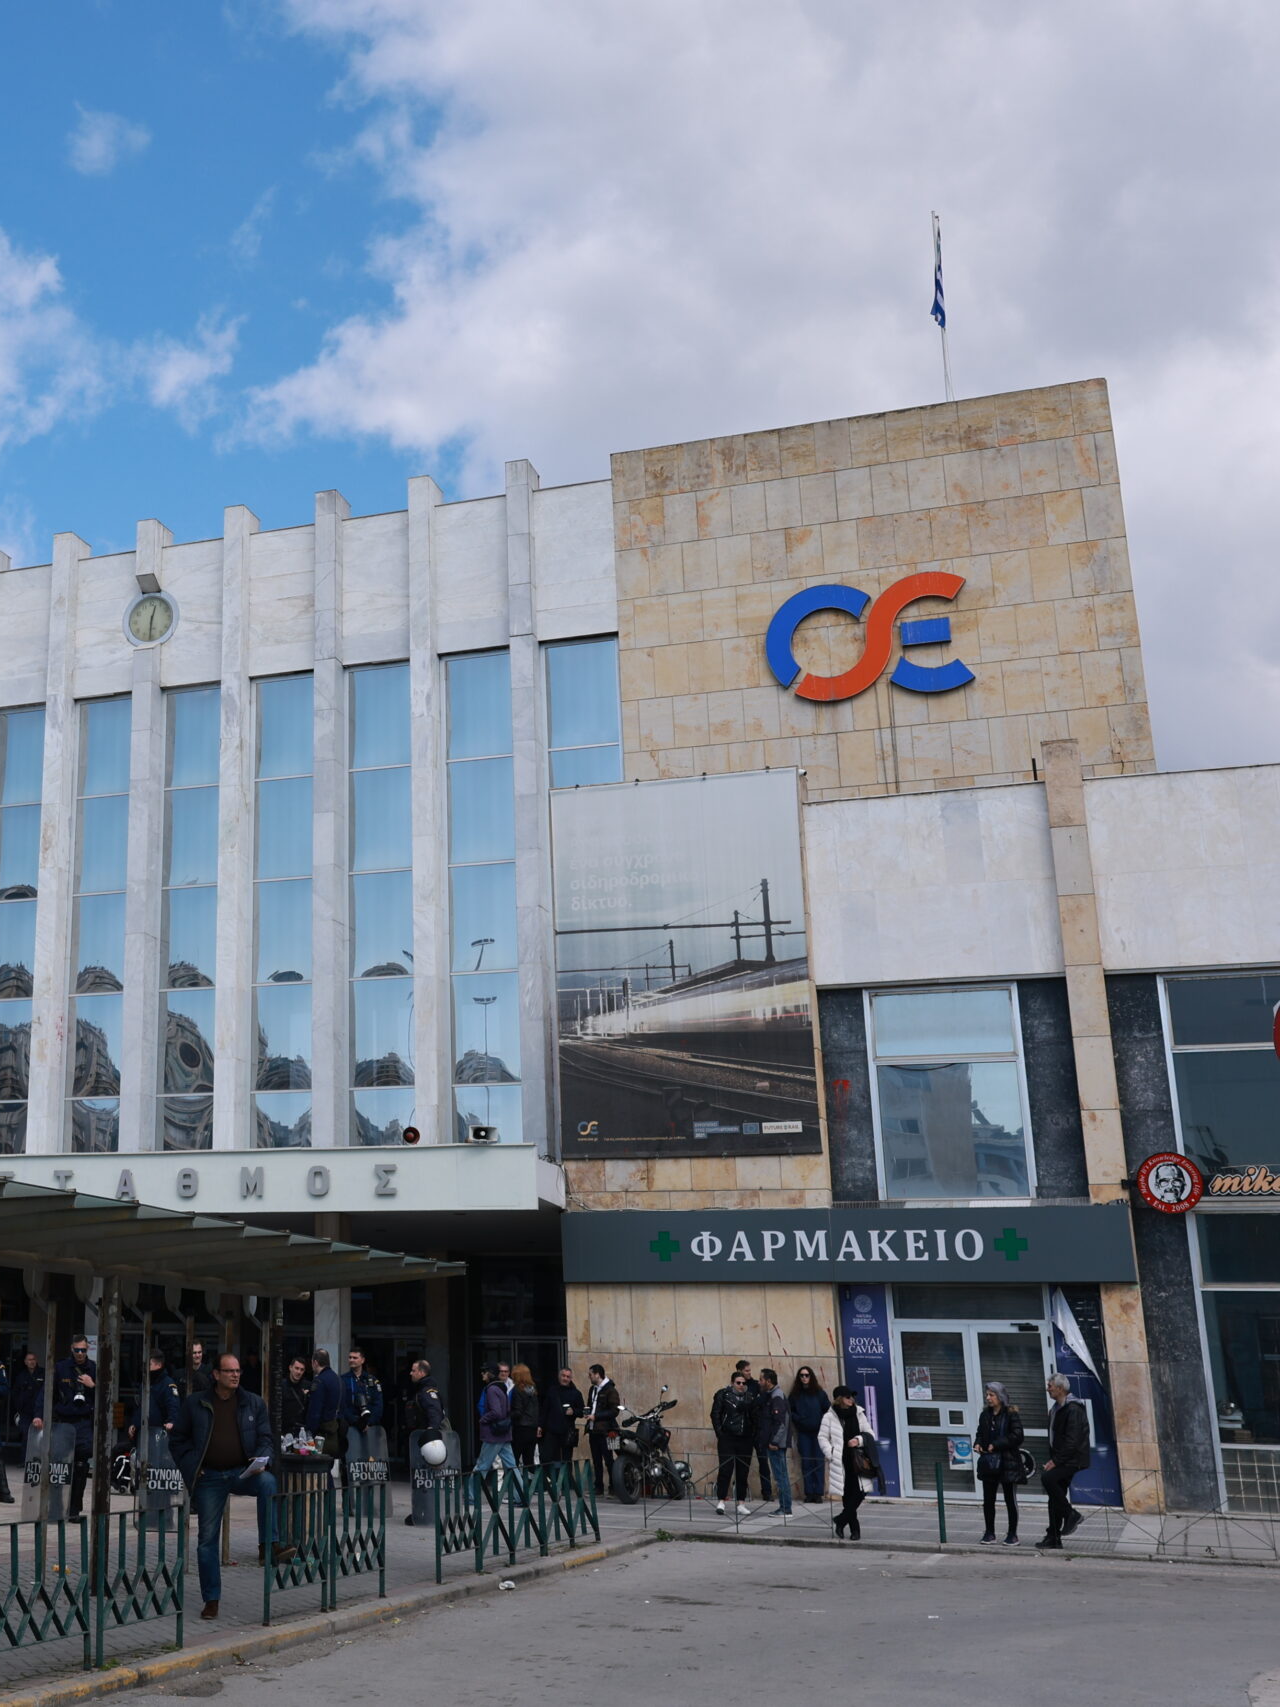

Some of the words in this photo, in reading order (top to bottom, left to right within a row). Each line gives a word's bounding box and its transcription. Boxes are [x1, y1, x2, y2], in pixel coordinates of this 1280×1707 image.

[1171, 1201, 1190, 1212] 2008
[690, 1229, 984, 1262] ΦΑΡΜΑΚΕΙΟ
[849, 1337, 883, 1345] ROYAL
[848, 1345, 885, 1354] CAVIAR
[349, 1462, 388, 1473] ΑΣΤΥΝΟΜΙΑ
[27, 1473, 66, 1484] POCE
[352, 1472, 388, 1481] POLICE
[148, 1480, 184, 1490] OLICE
